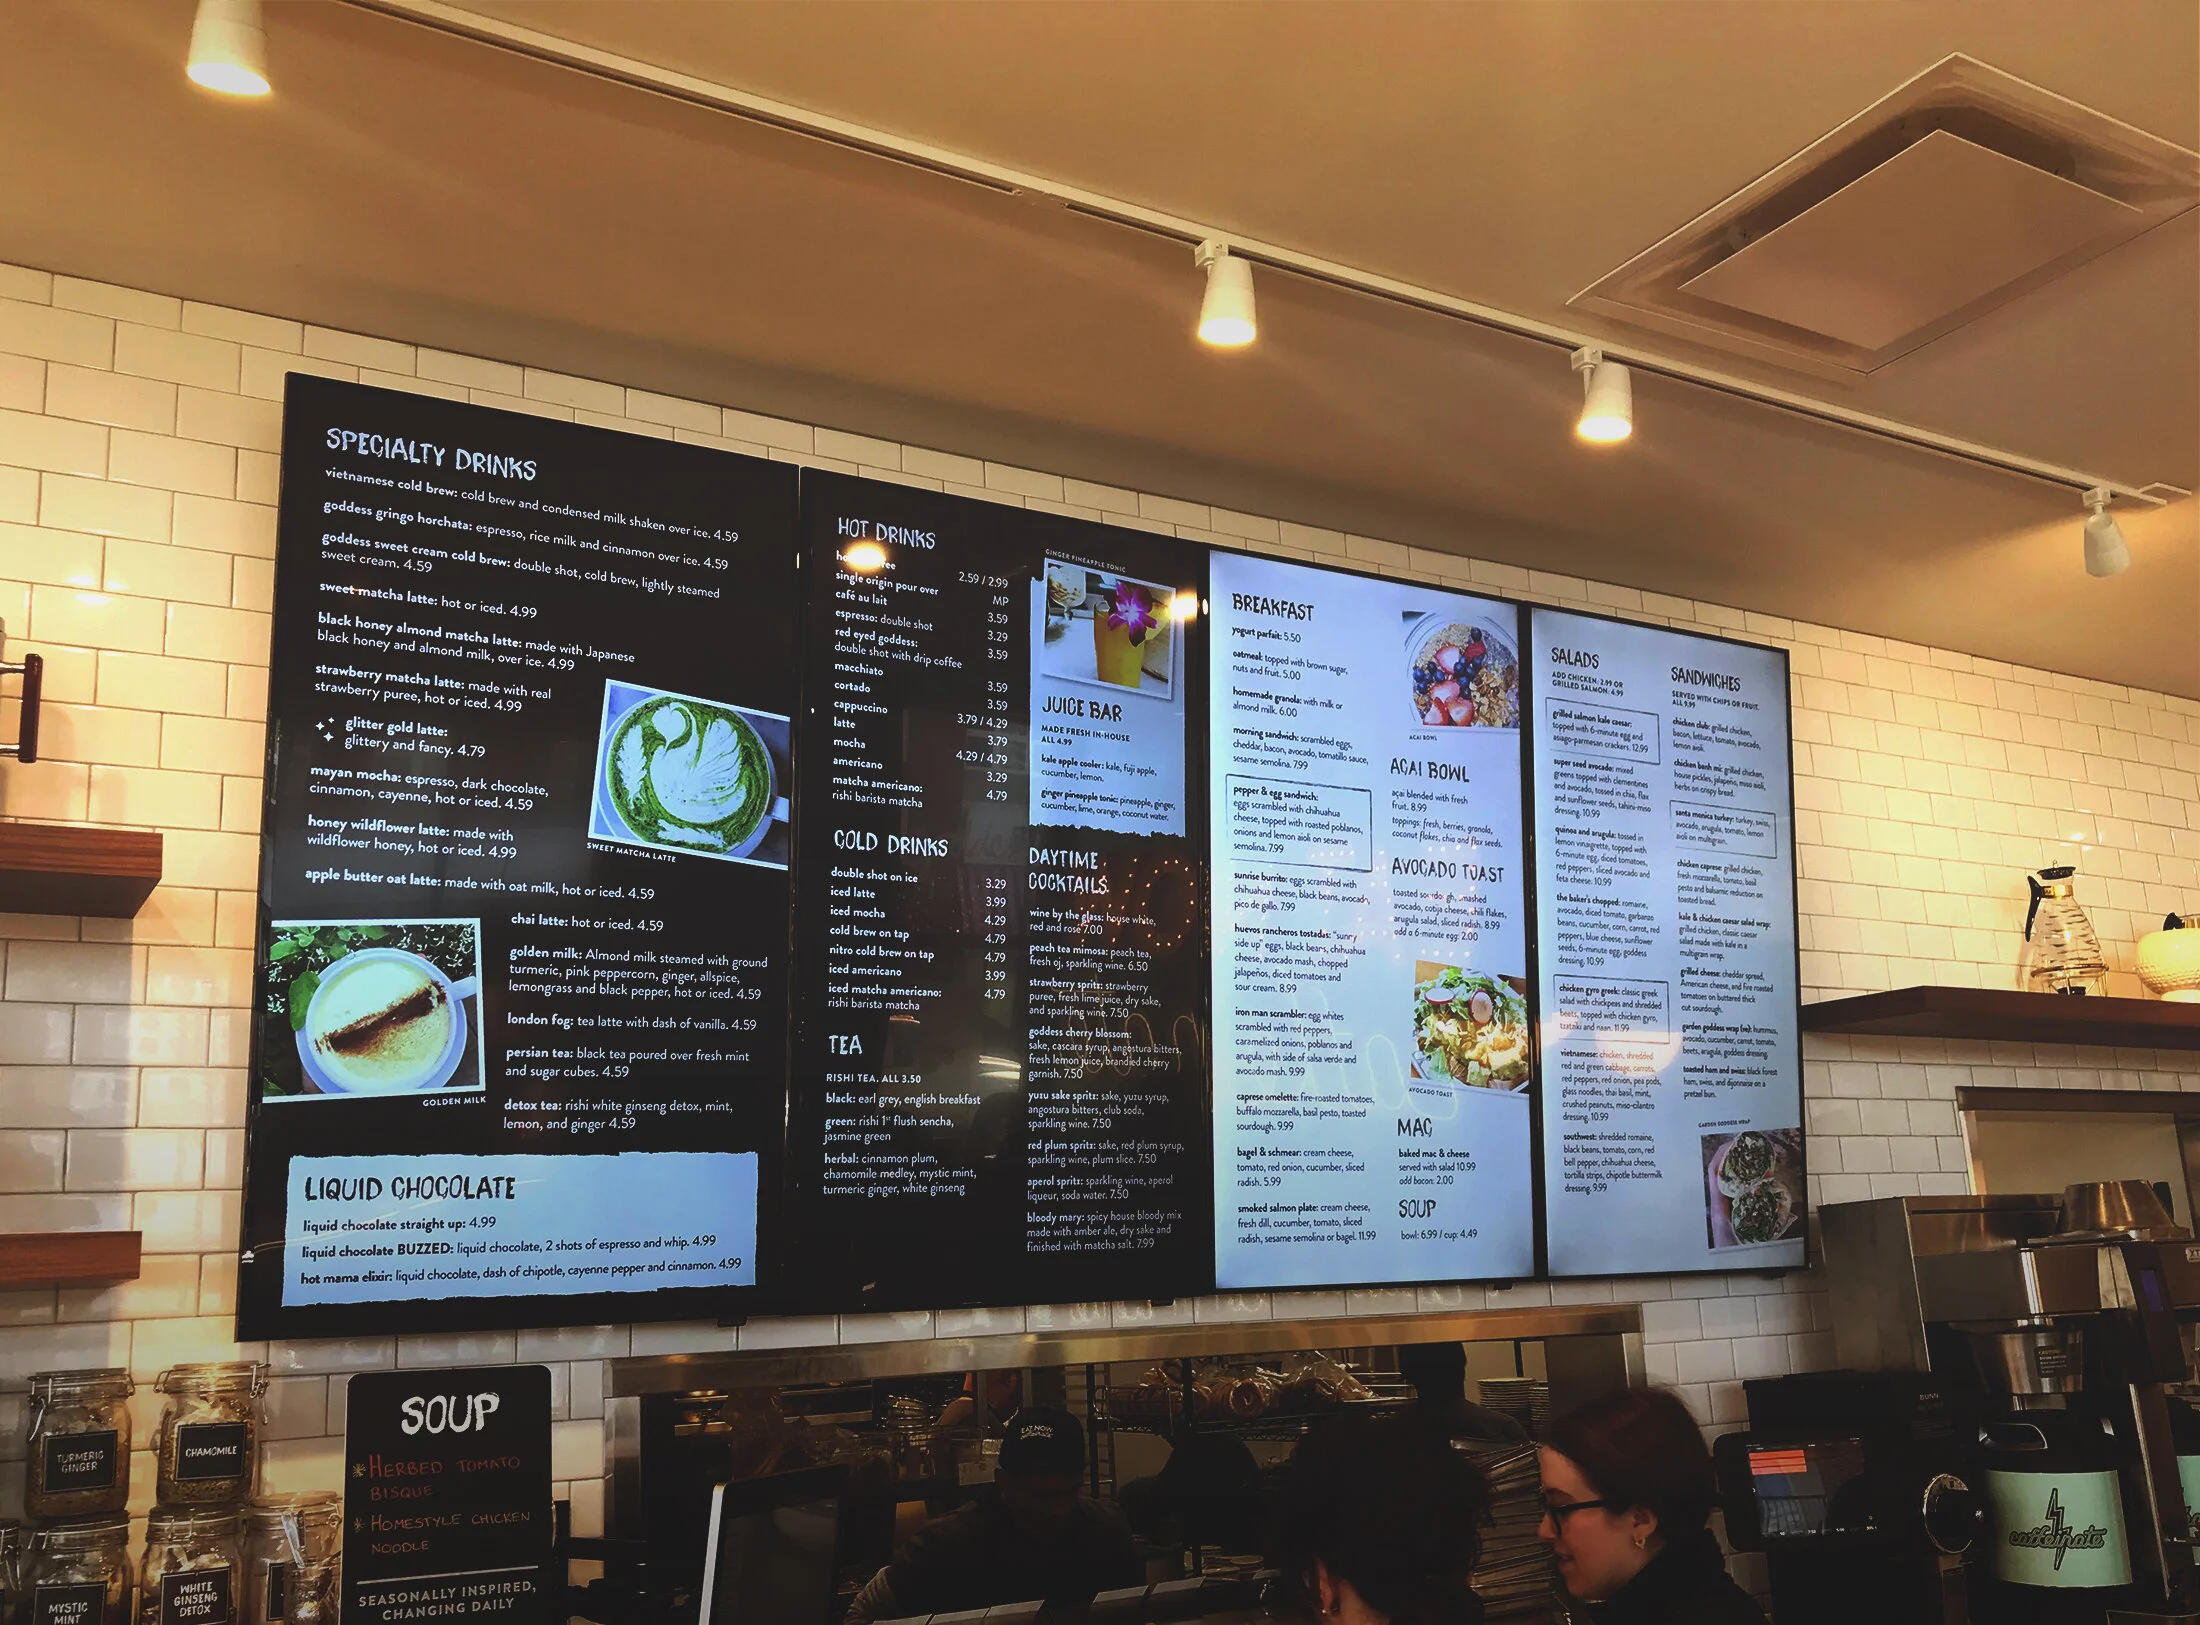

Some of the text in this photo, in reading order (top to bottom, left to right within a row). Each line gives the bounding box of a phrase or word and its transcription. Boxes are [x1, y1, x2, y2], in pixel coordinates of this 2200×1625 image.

[327, 428, 537, 481] SPECIALTY DRINKS
[325, 470, 738, 543] vietnamese cold brew: cold brew and condensed milk shaken over ice. 4.59
[838, 517, 935, 550] HOT DRINKS
[1045, 548, 1125, 573] GINGER PINEAPPLE TONIC
[836, 572, 939, 595] single origin pour over
[959, 571, 980, 584] 2.59
[988, 576, 1008, 589] 2.99
[319, 583, 537, 618] sweet matcha latte: hot or iced. 4.99
[835, 590, 856, 601] café
[872, 593, 887, 606] lait
[993, 595, 1009, 606] MP
[1232, 593, 1314, 621] BREAKFAST
[1232, 627, 1301, 643] yogurt parfait: 5.50
[1551, 647, 1599, 669] SALADS
[1671, 666, 1741, 692] SANDWICHES
[834, 701, 888, 714] cappuccino
[1042, 696, 1122, 722] JUICE BAR
[345, 716, 448, 737] glitter gold latte:
[834, 717, 856, 729] latte
[1041, 725, 1064, 734] MADE
[1066, 727, 1090, 737] FRESH
[834, 738, 866, 749] mocha
[1041, 736, 1072, 746] ALL 4.99
[833, 758, 883, 770] americano
[1390, 757, 1470, 783] ACAI BOWL
[1233, 786, 1318, 801] pepper & egg sandwich:
[587, 842, 676, 863] SWEET MATCHA LATTE
[834, 829, 948, 857] COLD DRINKS
[1030, 847, 1098, 869] DAYTIME
[1392, 857, 1504, 883] AVOCADO TOAST
[1029, 872, 1107, 895] COCKTAILS
[511, 912, 535, 924] chai
[538, 913, 568, 927] latte:
[571, 915, 590, 928] hot
[608, 917, 634, 930] iced.
[637, 920, 663, 932] 4.59
[830, 946, 853, 955] nitro
[856, 946, 876, 956] cold
[879, 946, 902, 957] brew
[919, 950, 935, 963] tap
[508, 1012, 757, 1030] london fog: tea latte with dash of vanilla. 4.59
[1029, 1027, 1132, 1041] goddess cherry blossom:
[829, 1034, 863, 1055] TEA
[826, 1073, 854, 1082] RISHI
[881, 1074, 899, 1083] ALL
[902, 1074, 921, 1083] 3.50
[422, 1096, 486, 1107] GOLDEN MILK
[1409, 1087, 1453, 1098] AVOCADO TOAST
[1398, 1117, 1432, 1137] MAC
[305, 1175, 515, 1201] LIQUID CHOCOLATE
[1399, 1199, 1436, 1218] SOUP
[303, 1216, 496, 1235] liquid chocolate straight up: 4.99
[1401, 1230, 1419, 1240] bowl:
[1421, 1229, 1438, 1240] 6.99
[1444, 1232, 1458, 1242] cup:
[1460, 1229, 1478, 1238] 4.49
[401, 1392, 500, 1435] SOUP
[57, 1450, 104, 1463] TURMERIC
[185, 1446, 237, 1458] CHAMOMILE
[61, 1461, 98, 1473] GINGER
[369, 1454, 520, 1479] HERBED TOMATO
[371, 1485, 434, 1501] BISQUE
[371, 1512, 531, 1532] HOMESTYLE CHICKEN
[2009, 1525, 2107, 1549] caffeinate
[372, 1540, 430, 1554] NOODLE
[180, 1581, 212, 1594] WHITE
[359, 1581, 537, 1607] SEASONALLY INSPIRED,
[48, 1602, 88, 1614] MYSTIC
[174, 1592, 218, 1606] GINSENG
[180, 1604, 211, 1617] DETOX
[382, 1598, 515, 1621] CHANGING DAILY
[54, 1614, 81, 1625] MINT
